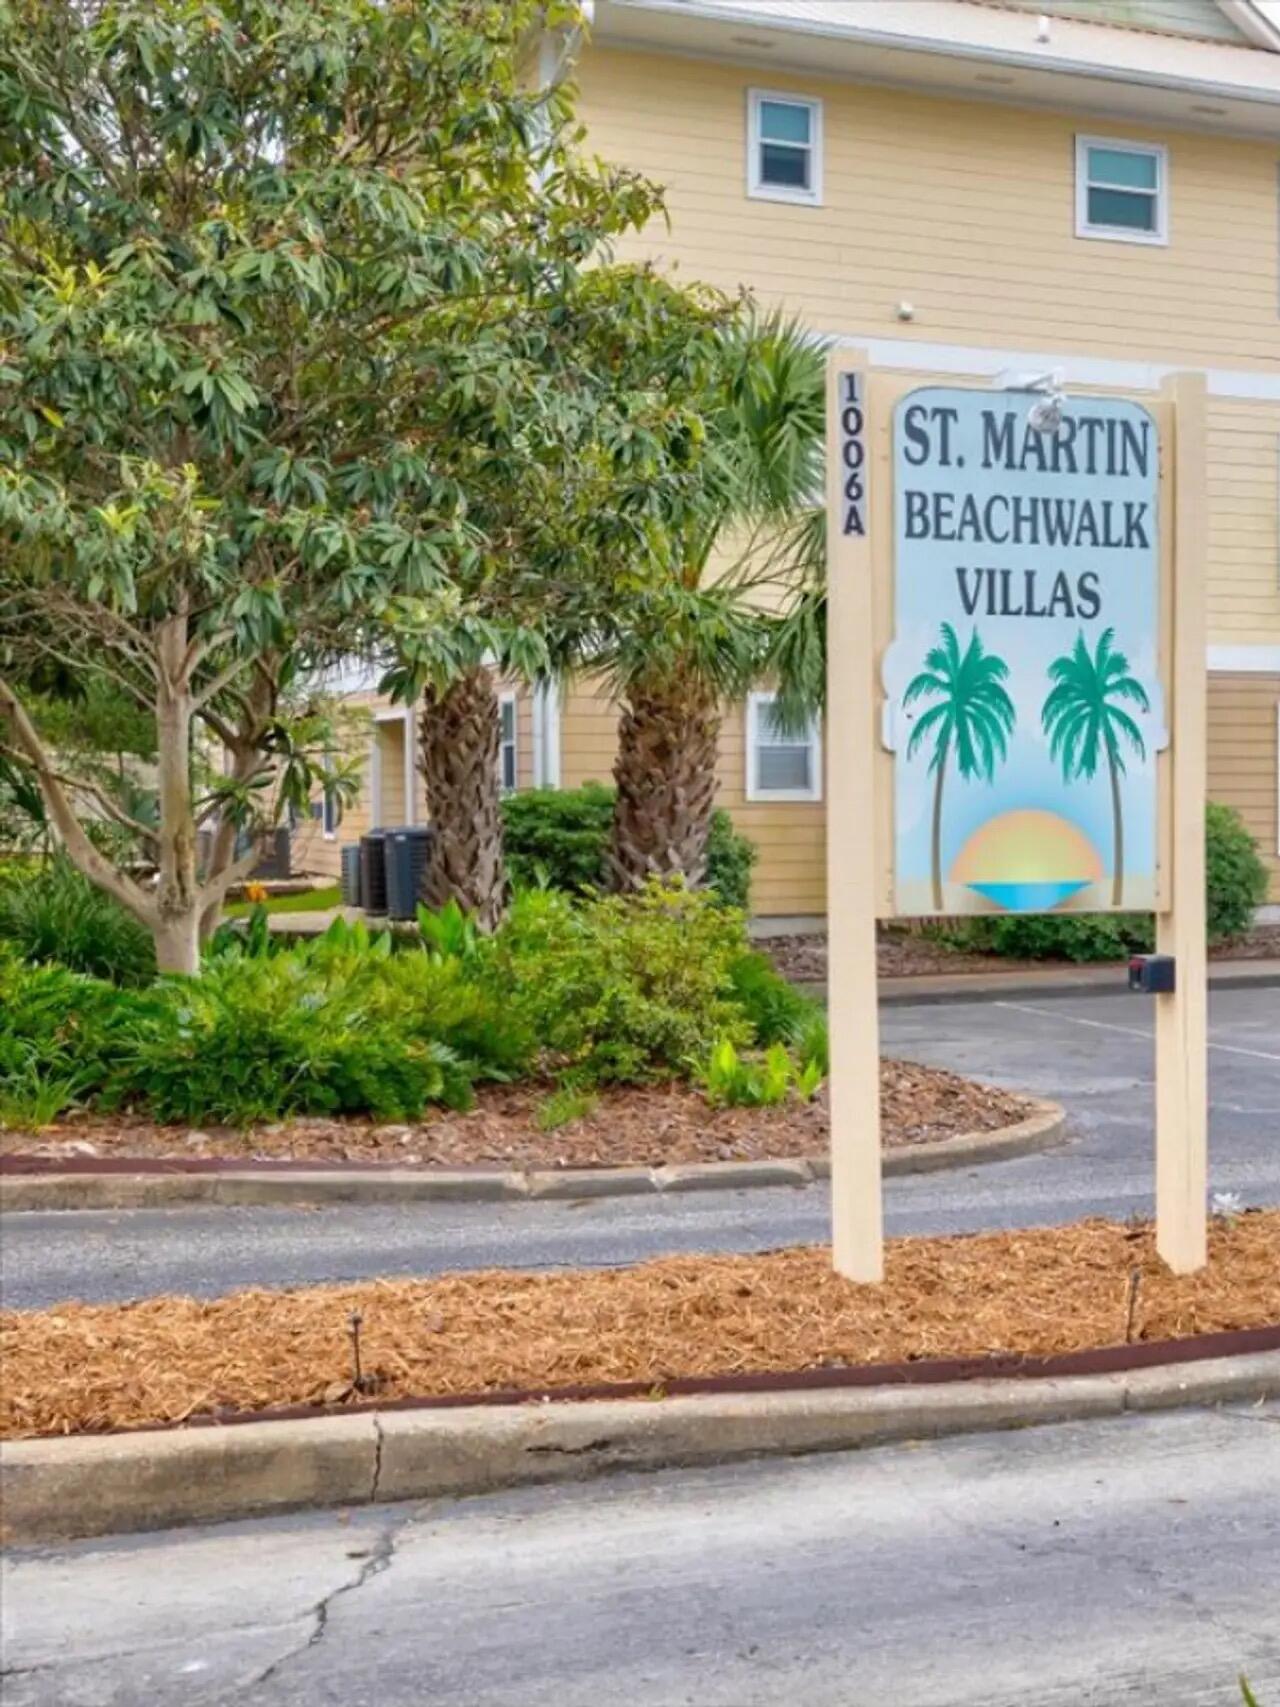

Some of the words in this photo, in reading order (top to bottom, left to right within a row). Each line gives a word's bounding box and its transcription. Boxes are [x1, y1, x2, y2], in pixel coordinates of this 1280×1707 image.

[842, 373, 865, 536] 1006A
[904, 405, 965, 468] ST.
[981, 411, 1150, 478] MARTIN
[904, 490, 1150, 549] BEACHWALK
[956, 567, 1102, 619] VILLAS
